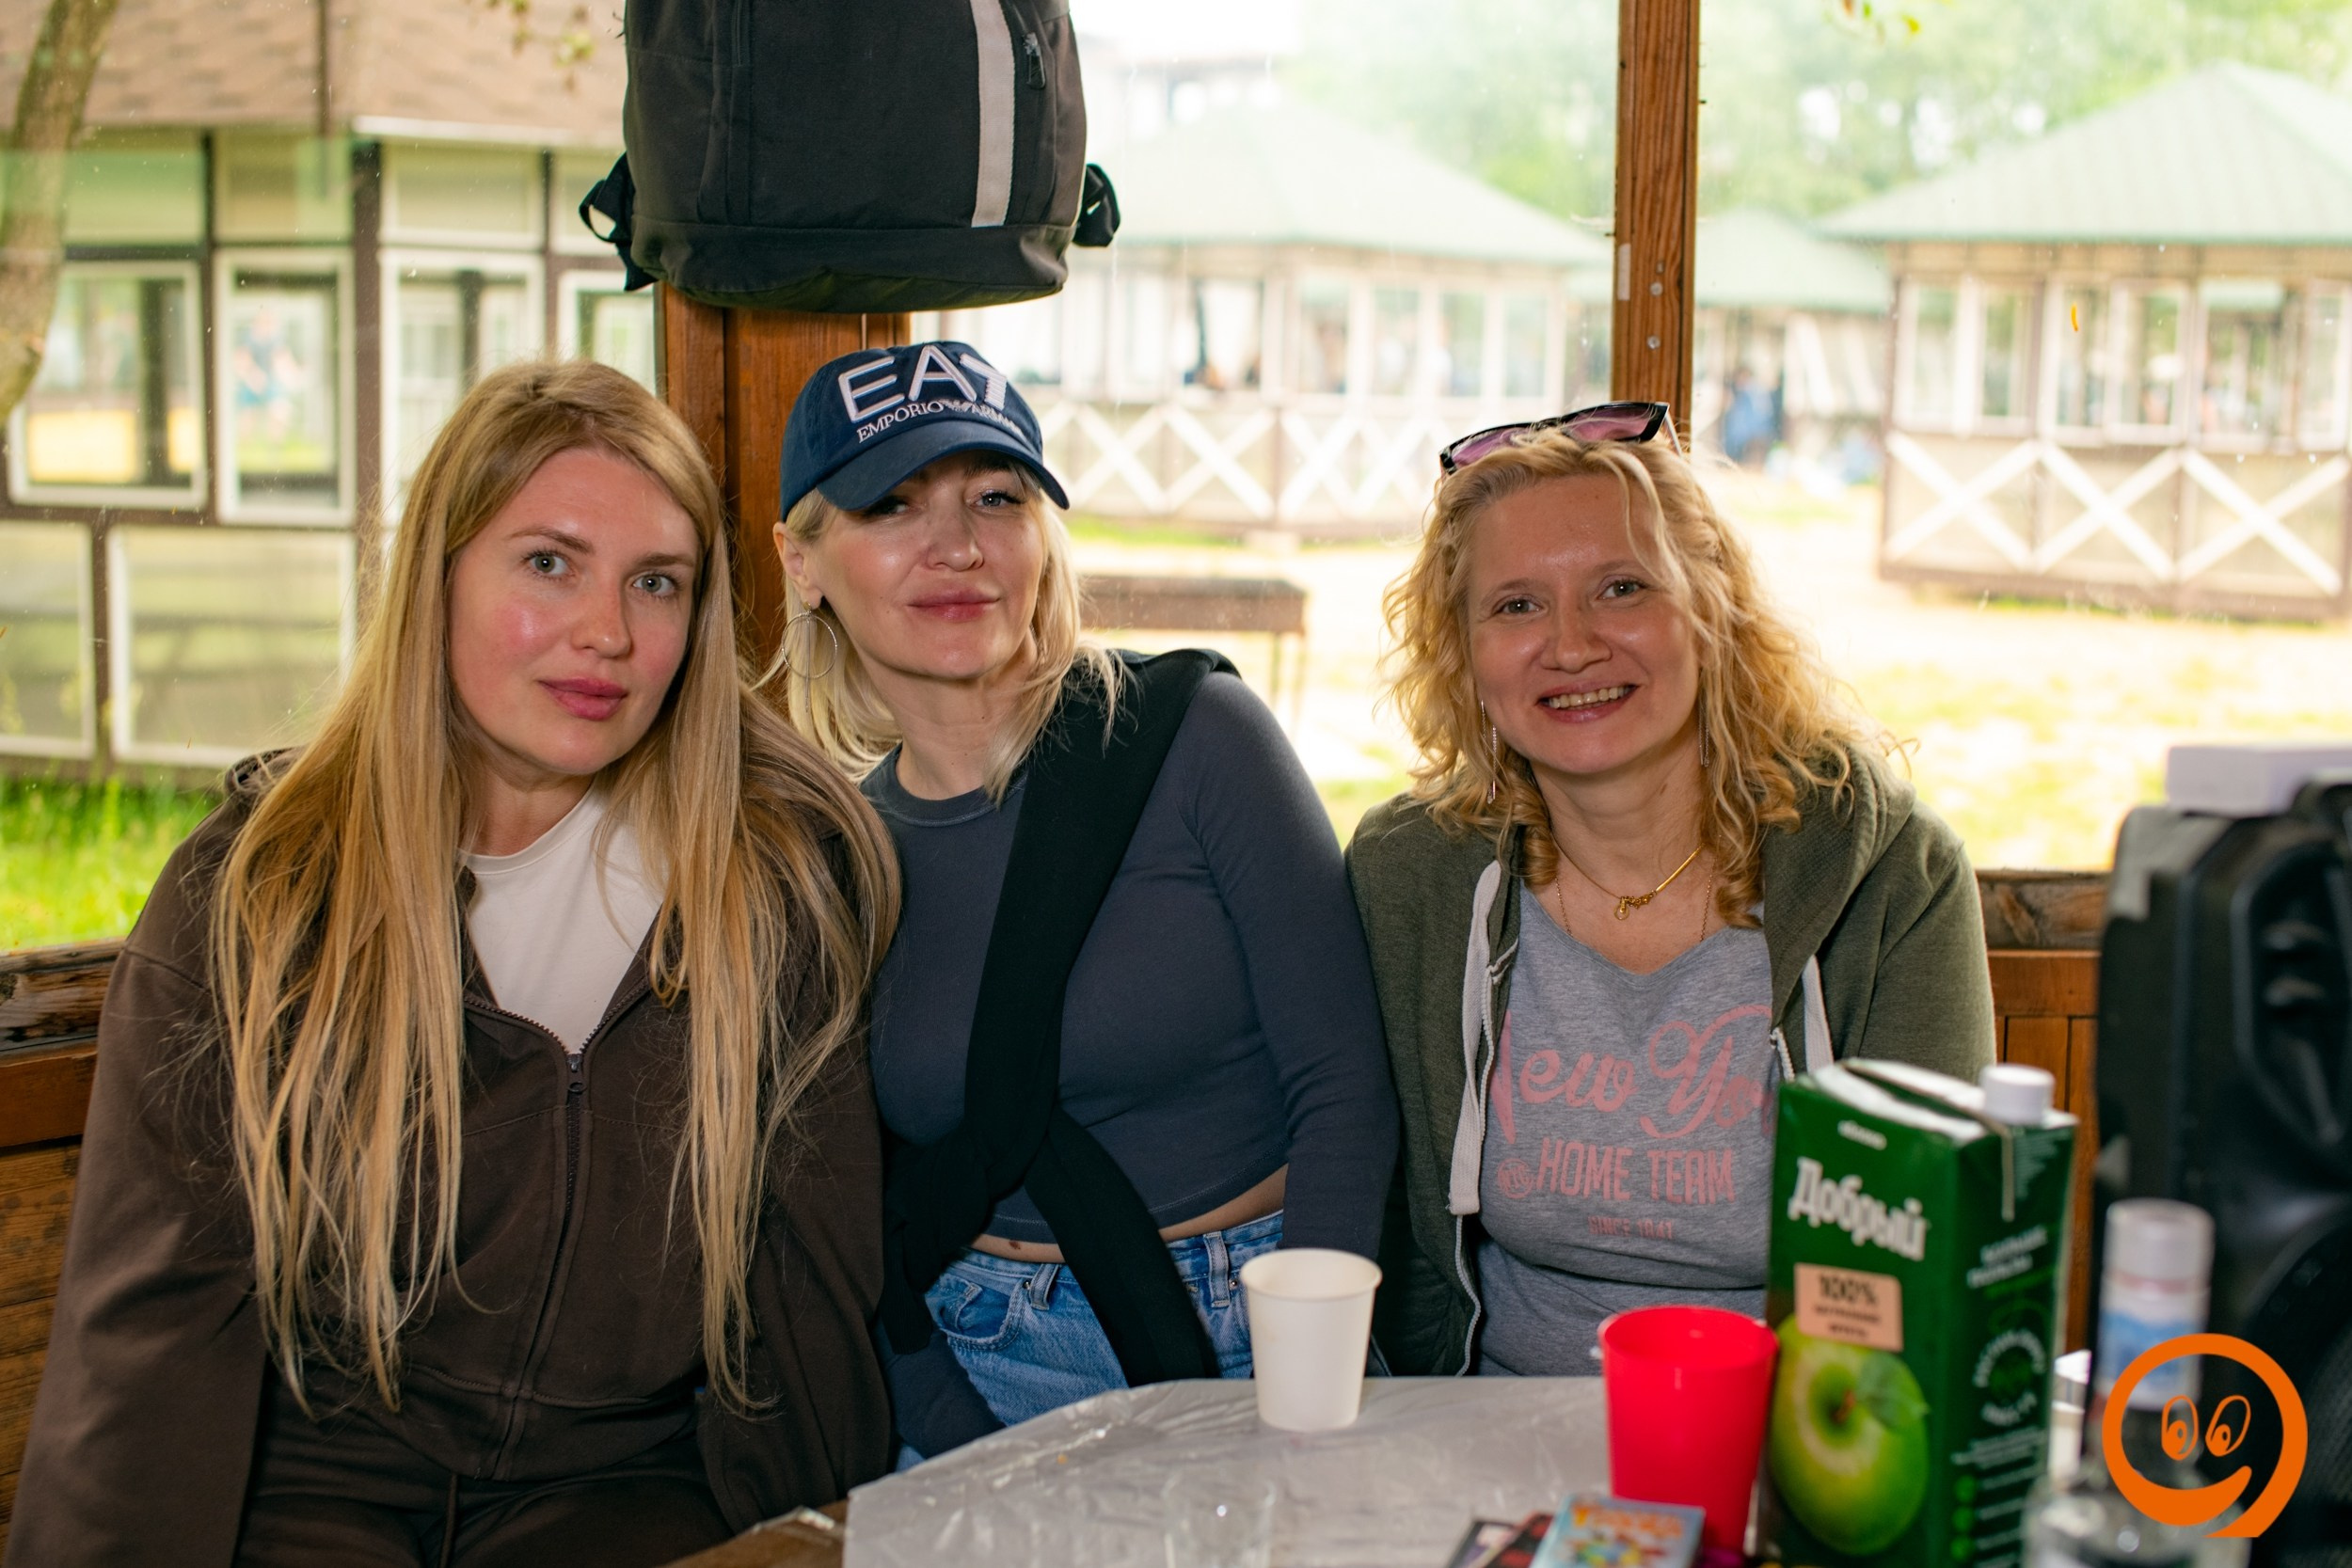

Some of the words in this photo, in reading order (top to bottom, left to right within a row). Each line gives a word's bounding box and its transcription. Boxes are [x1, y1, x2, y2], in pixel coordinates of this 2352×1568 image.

[838, 344, 1008, 423] EA7
[856, 400, 945, 444] EMPORIO
[1639, 1004, 1774, 1139] Yo
[1535, 1137, 1633, 1201] HOME
[1646, 1148, 1736, 1205] TEAM
[1587, 1215, 1630, 1238] SINCE
[1788, 1156, 1927, 1261] Добрый
[1819, 1274, 1878, 1307] 100%
